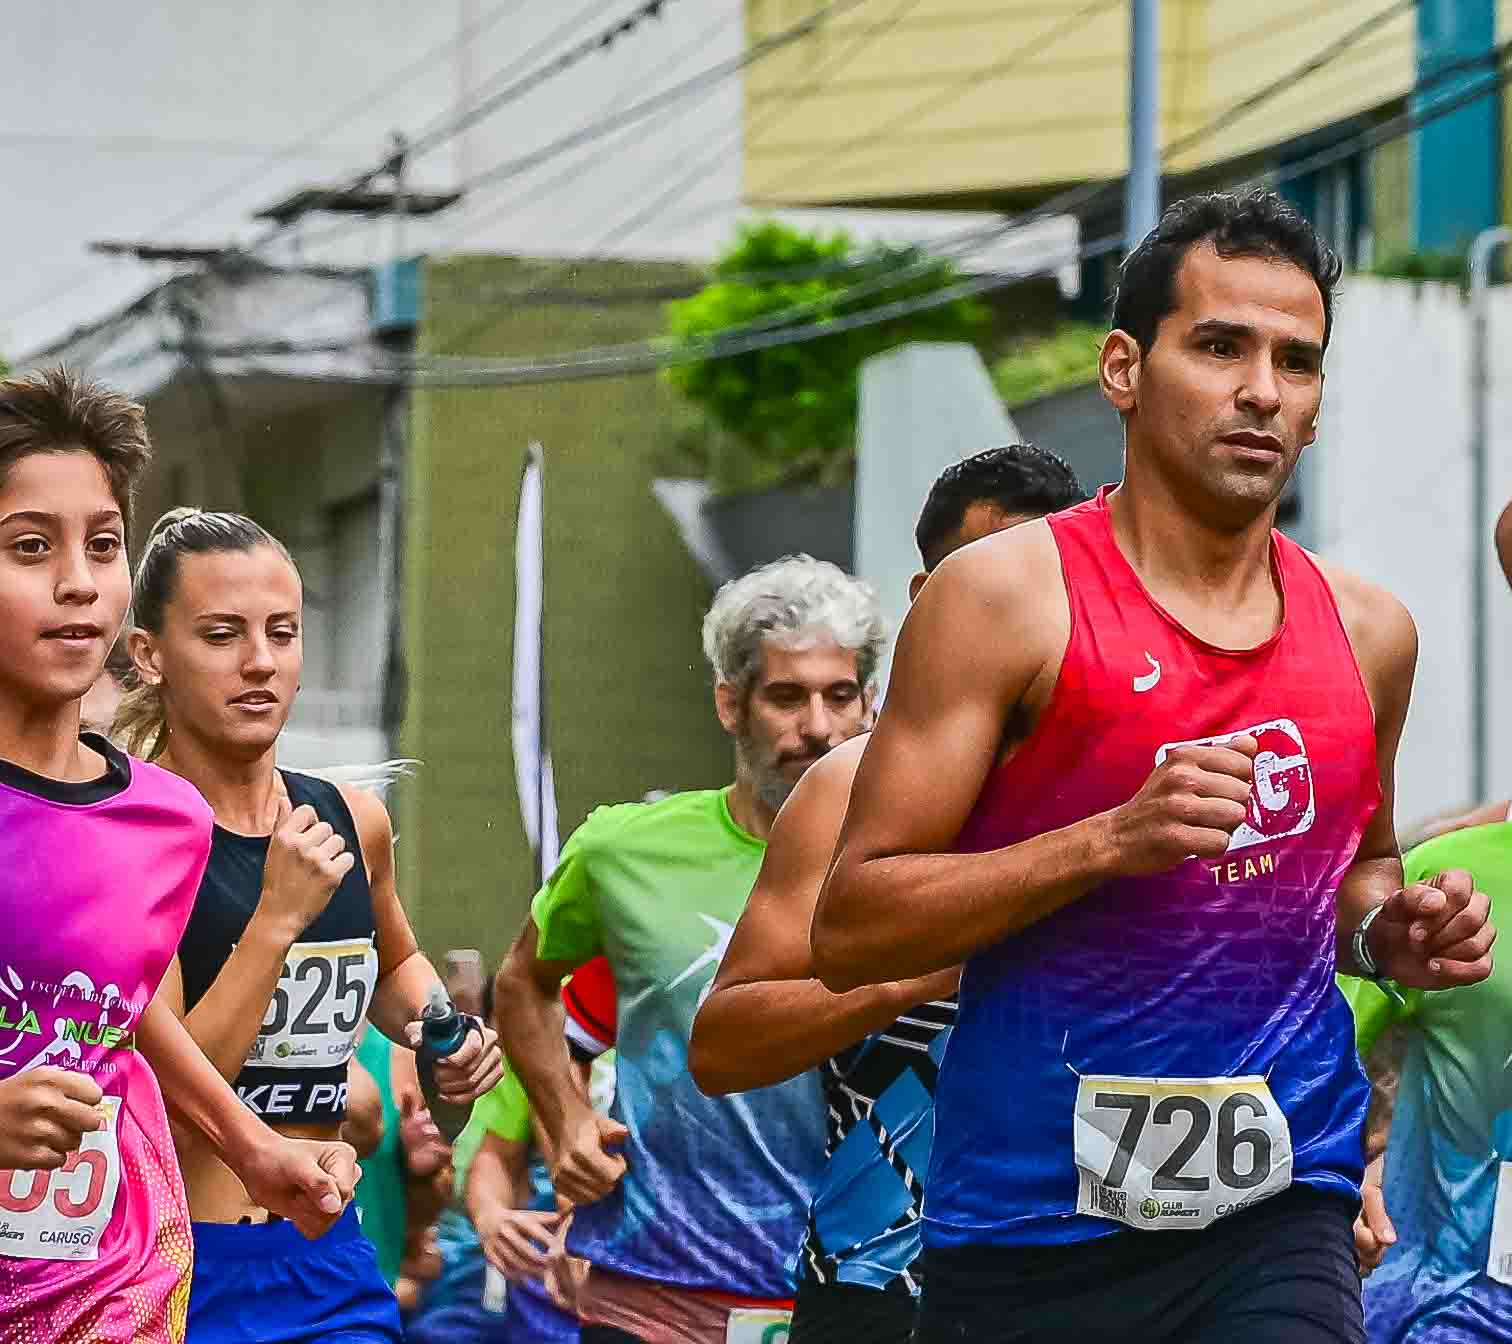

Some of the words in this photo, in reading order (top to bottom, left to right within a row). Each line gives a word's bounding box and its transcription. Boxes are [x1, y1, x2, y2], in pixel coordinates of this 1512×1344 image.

[1209, 853, 1275, 886] TEAM
[1093, 1091, 1273, 1190] 726
[38, 1230, 92, 1246] CARUSO
